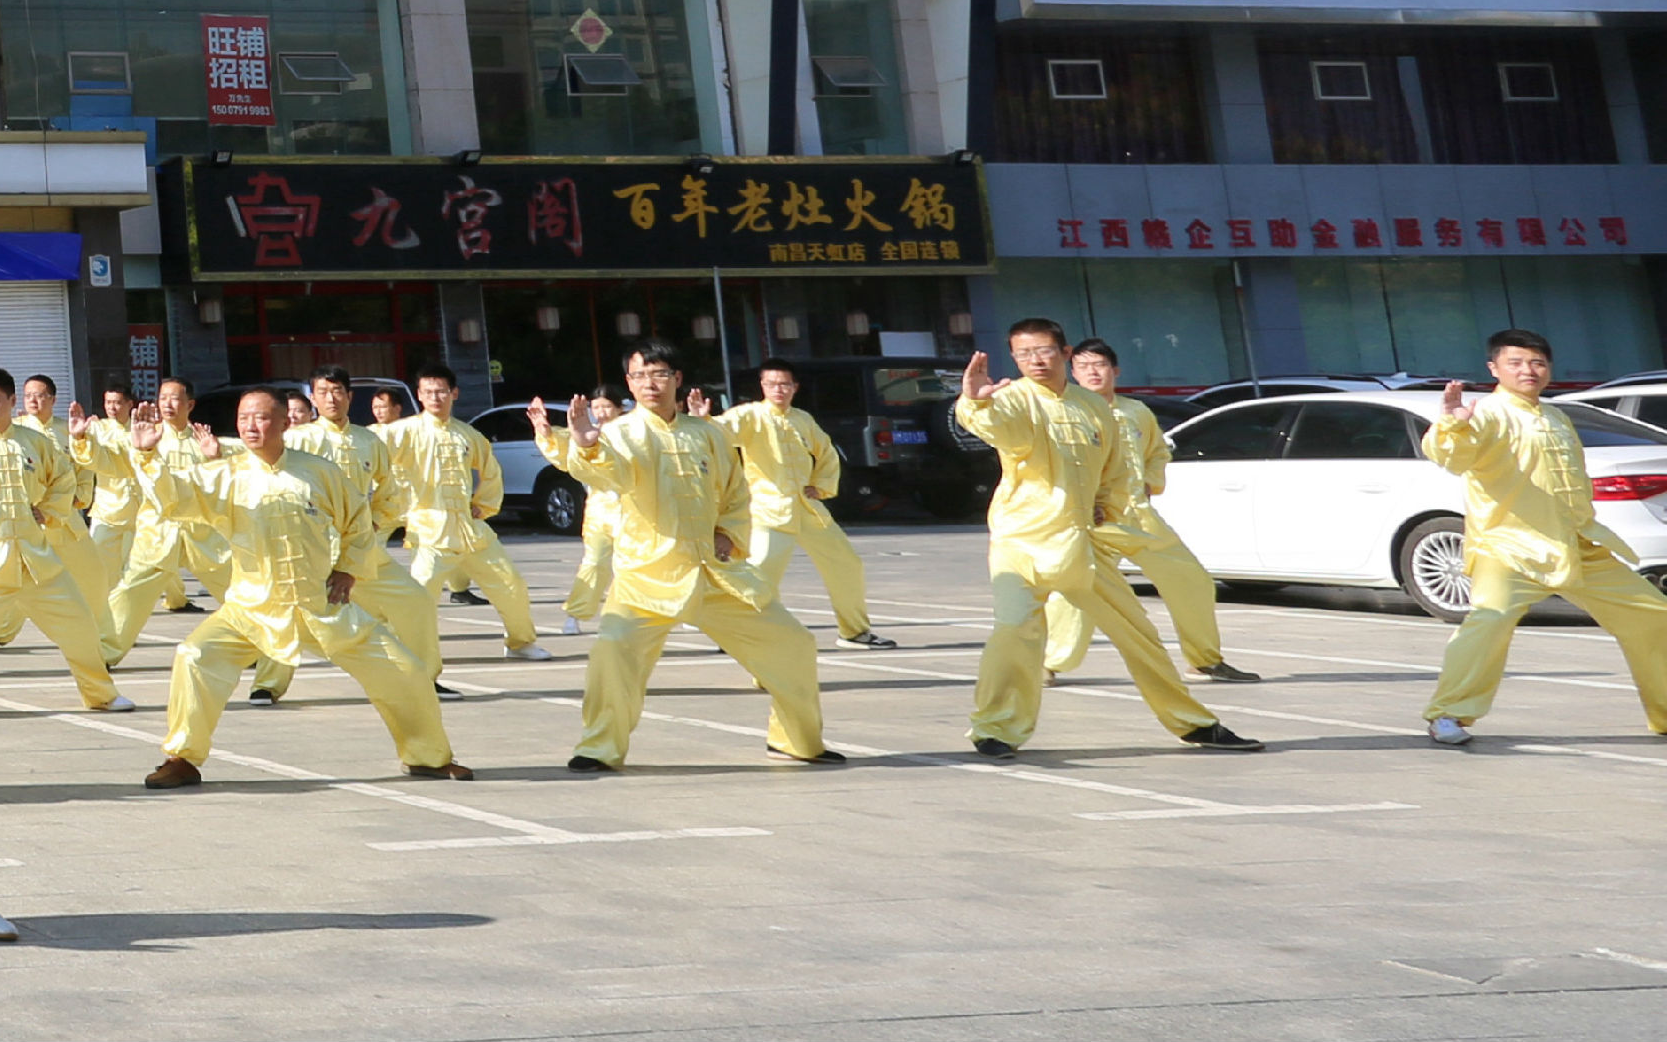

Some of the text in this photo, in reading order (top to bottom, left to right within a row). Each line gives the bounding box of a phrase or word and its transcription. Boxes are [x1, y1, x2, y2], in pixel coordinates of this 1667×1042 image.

[208, 27, 265, 56] 旺铺
[210, 59, 267, 88] 招租
[613, 175, 957, 238] 百年老灶火锅
